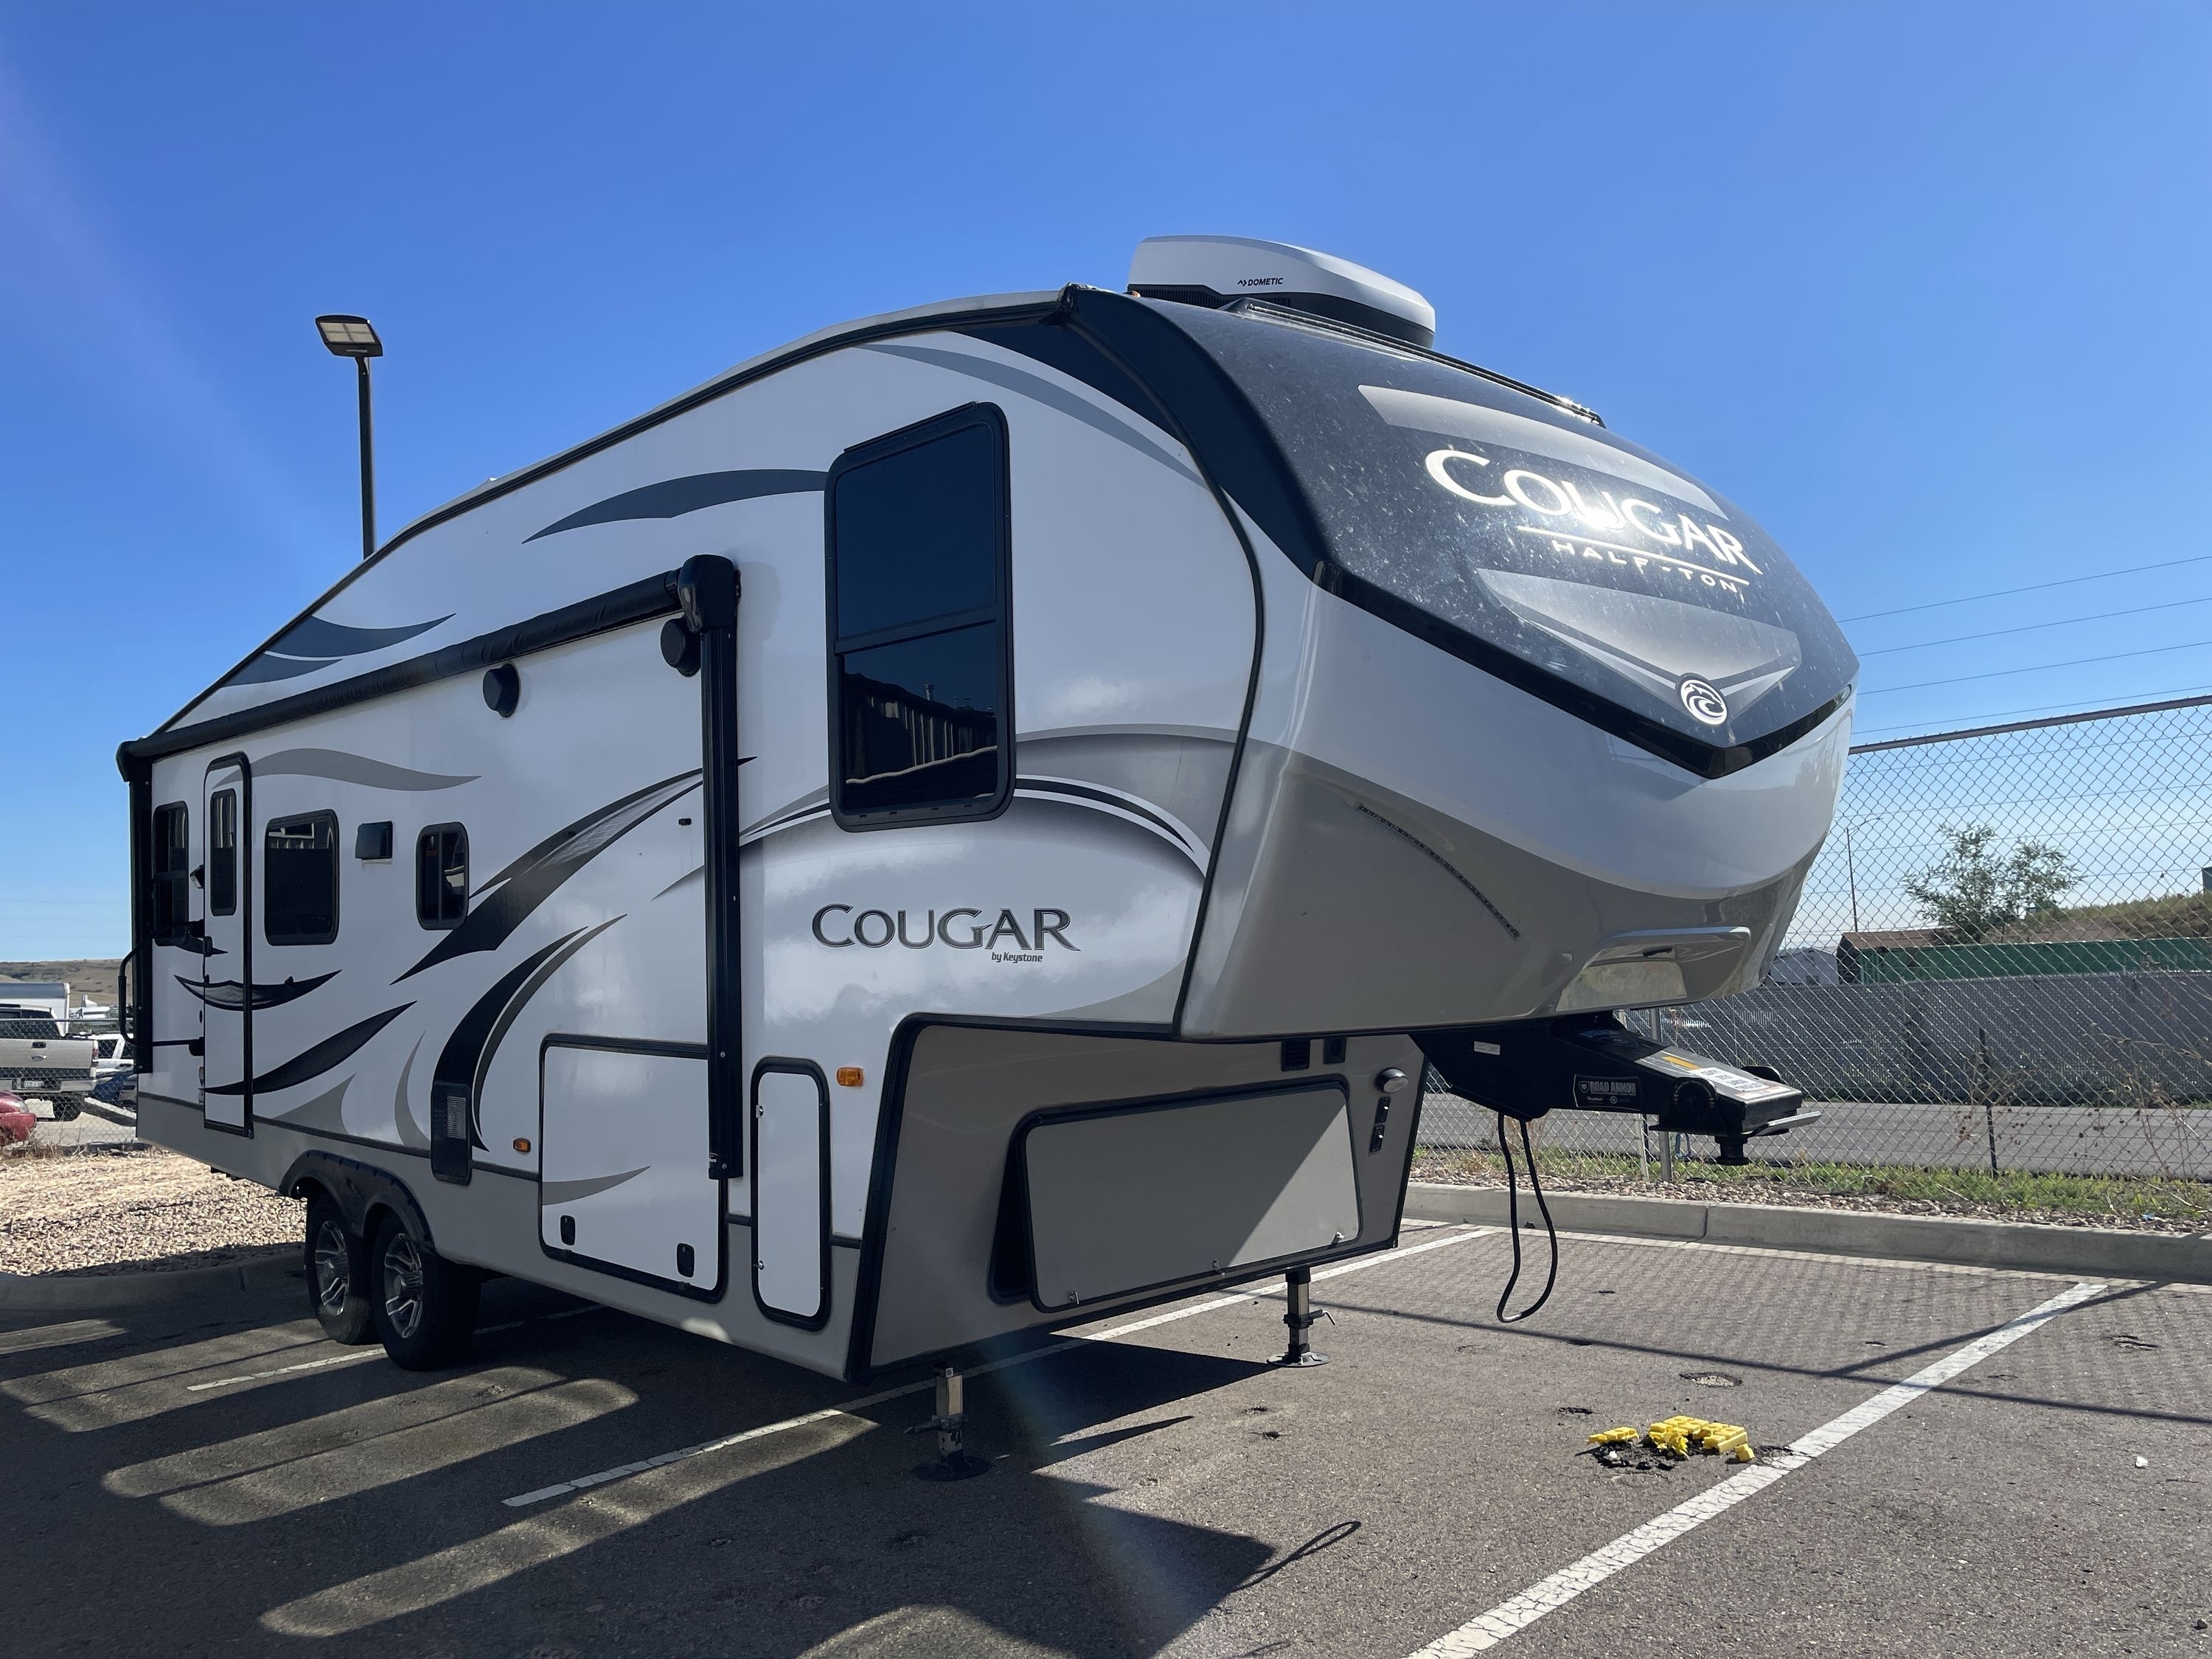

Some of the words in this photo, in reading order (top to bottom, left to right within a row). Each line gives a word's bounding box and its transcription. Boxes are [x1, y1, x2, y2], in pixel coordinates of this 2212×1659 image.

[1248, 277, 1284, 287] DOMETIC
[1425, 448, 1764, 575] COUGAR
[1551, 539, 1739, 594] HALF-TON
[812, 903, 1082, 952] COUGAR
[991, 951, 1002, 963] by
[1003, 952, 1043, 964] Keystone
[1590, 1081, 1610, 1093] ROAD
[1610, 1082, 1636, 1094] ARMOR
